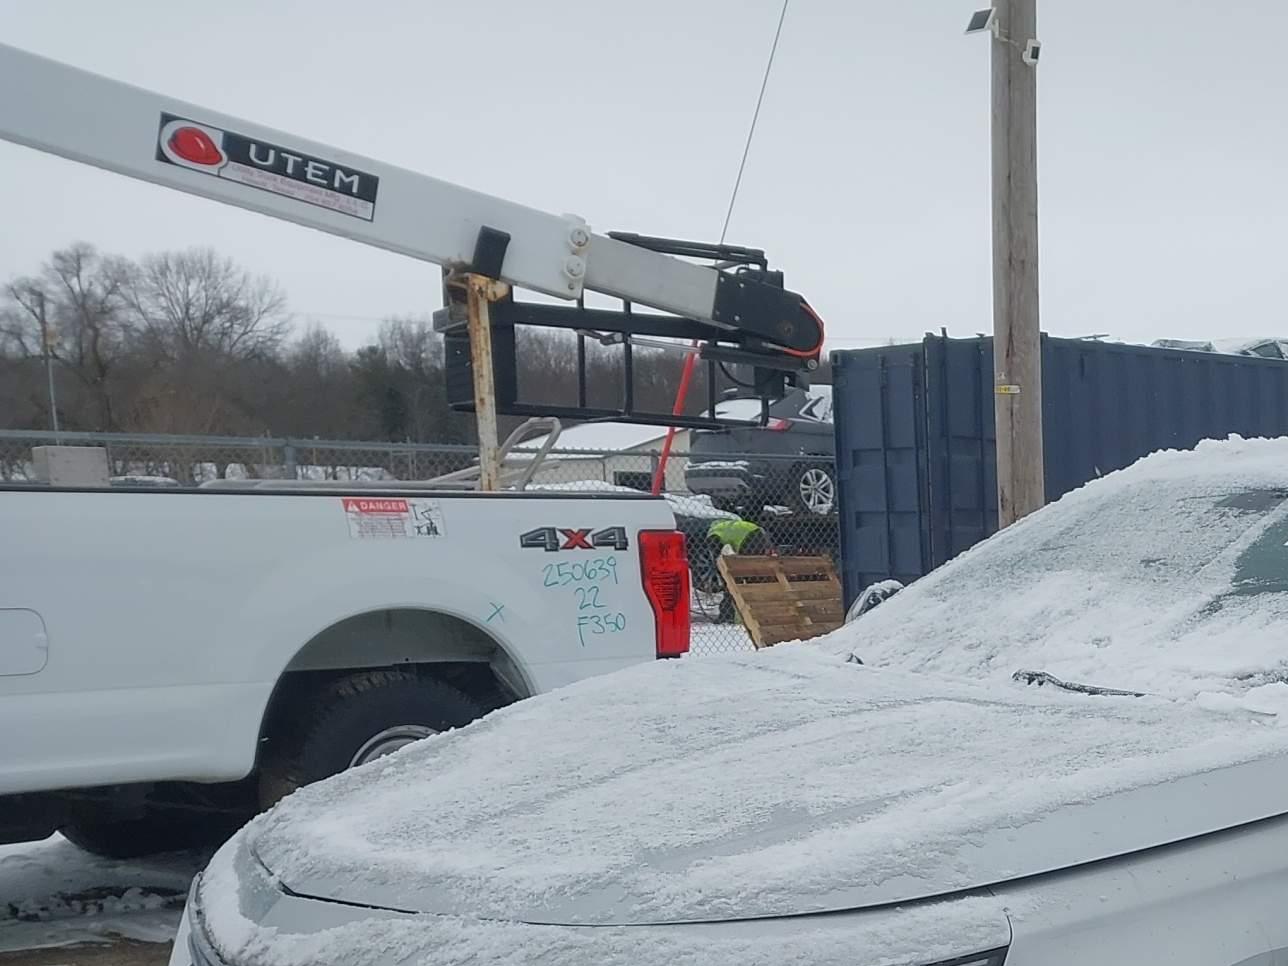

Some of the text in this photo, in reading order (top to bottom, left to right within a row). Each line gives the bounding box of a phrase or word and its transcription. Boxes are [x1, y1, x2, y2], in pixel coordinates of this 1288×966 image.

[249, 143, 360, 193] UTEM
[360, 501, 407, 511] DANGER
[542, 555, 618, 588] 250639
[574, 586, 607, 611] 22
[576, 612, 627, 647] F350
